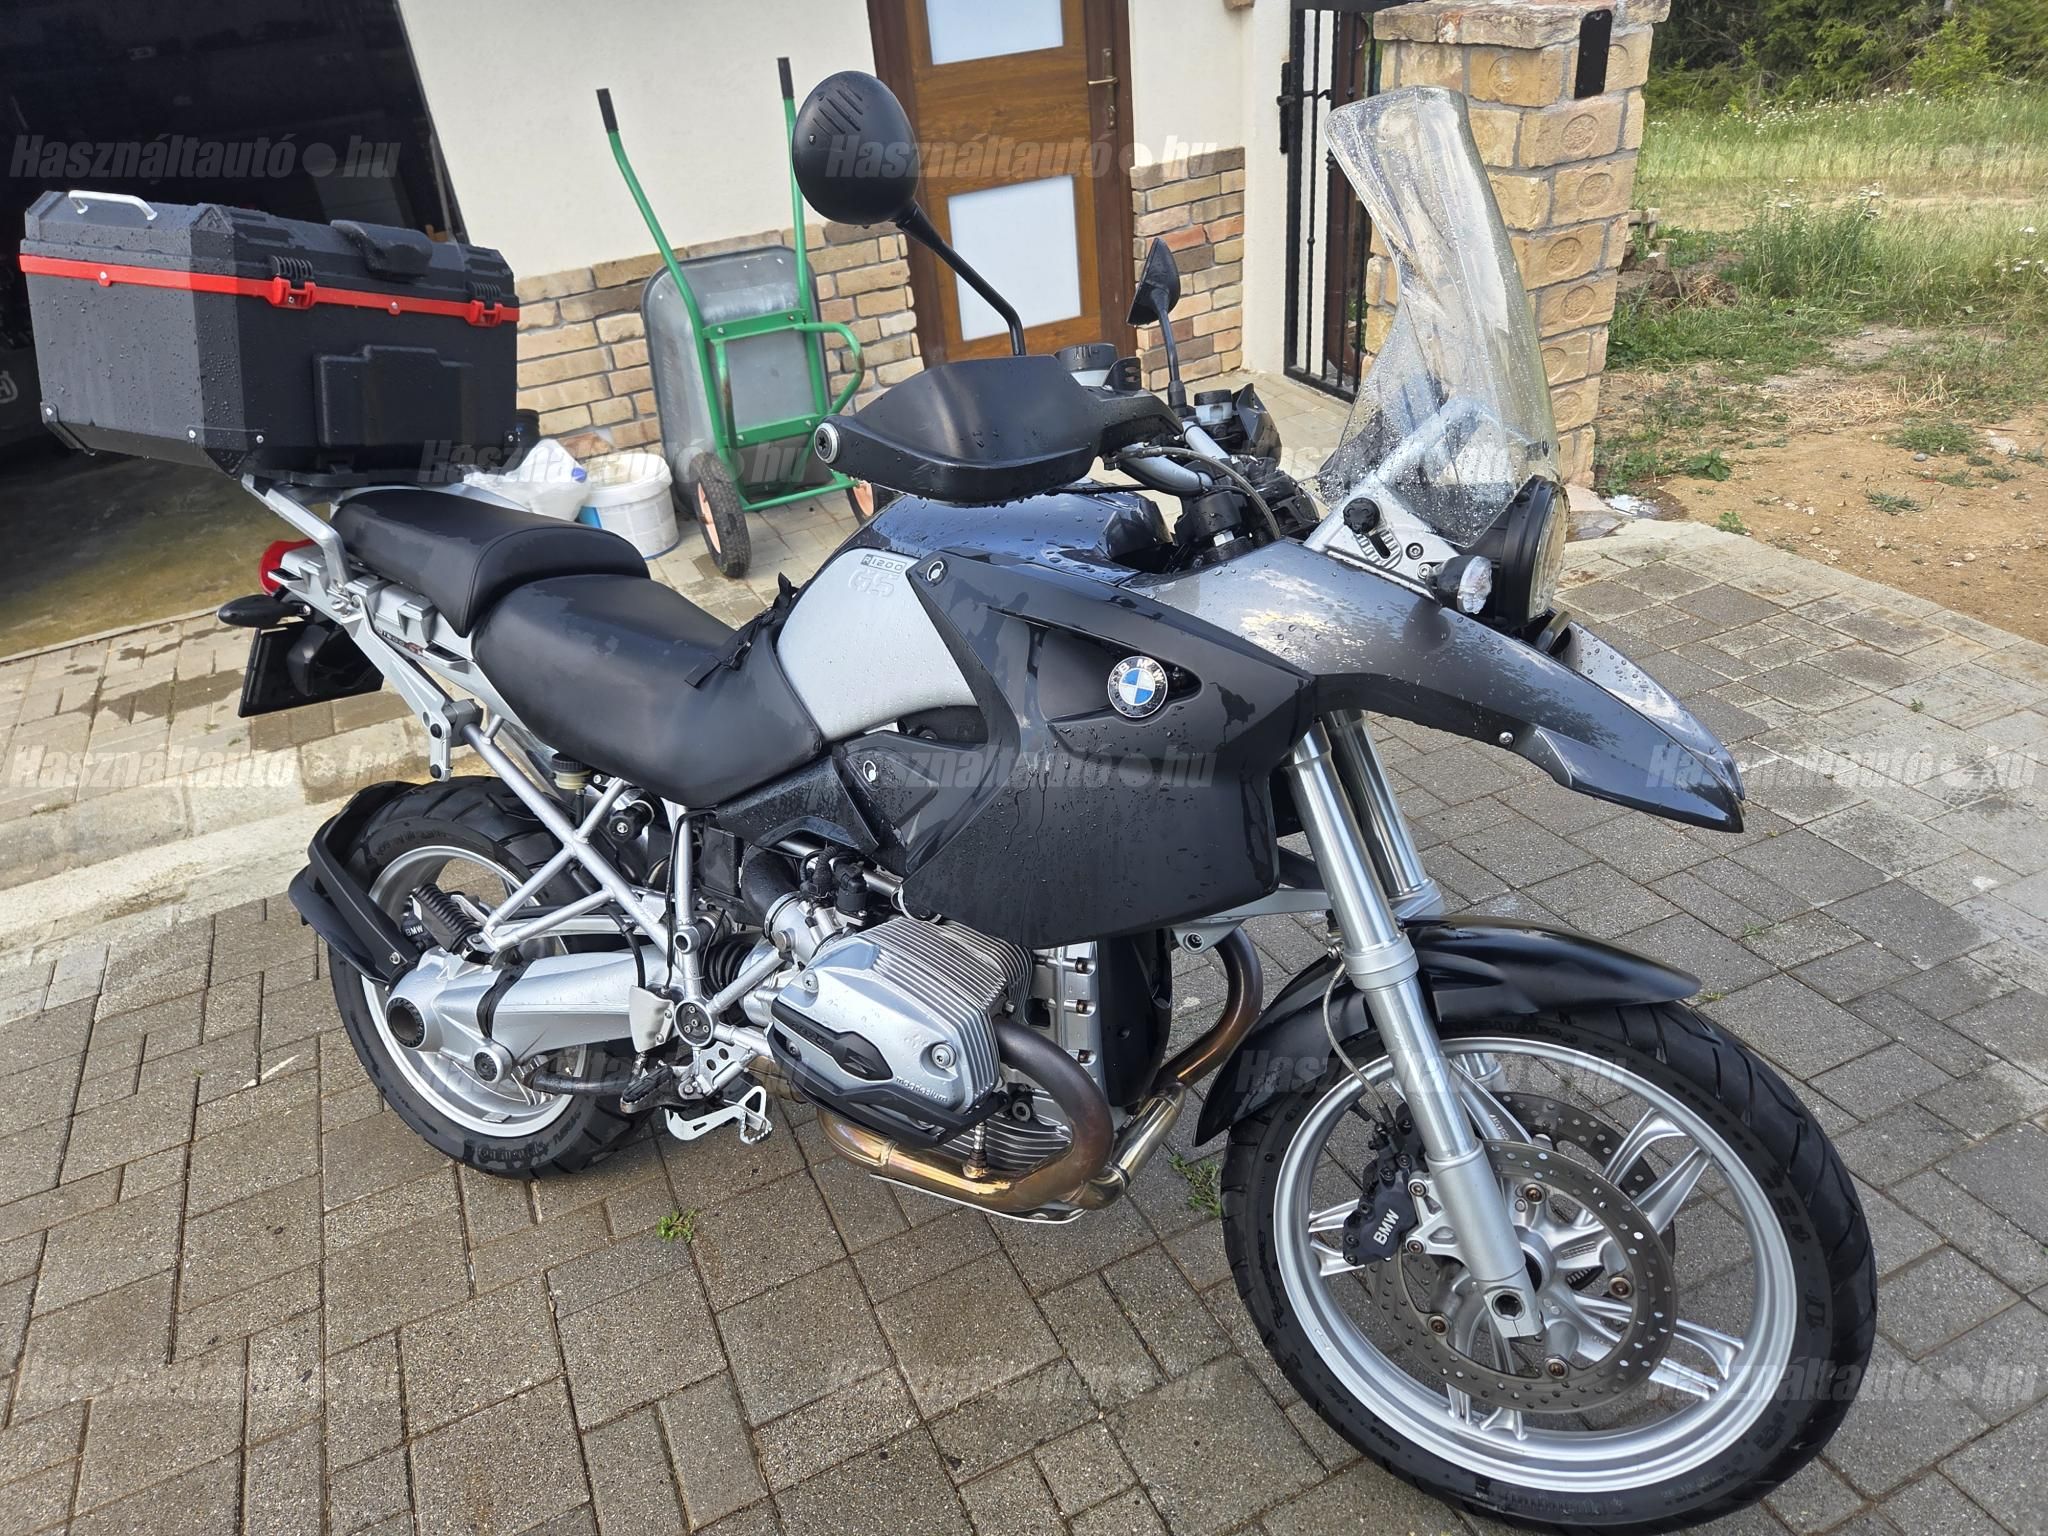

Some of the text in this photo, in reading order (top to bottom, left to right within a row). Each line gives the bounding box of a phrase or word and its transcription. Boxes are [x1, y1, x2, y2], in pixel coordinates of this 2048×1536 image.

[1117, 658, 1166, 687] BMW
[405, 925, 424, 937] BMW
[1373, 1208, 1400, 1246] BMW
